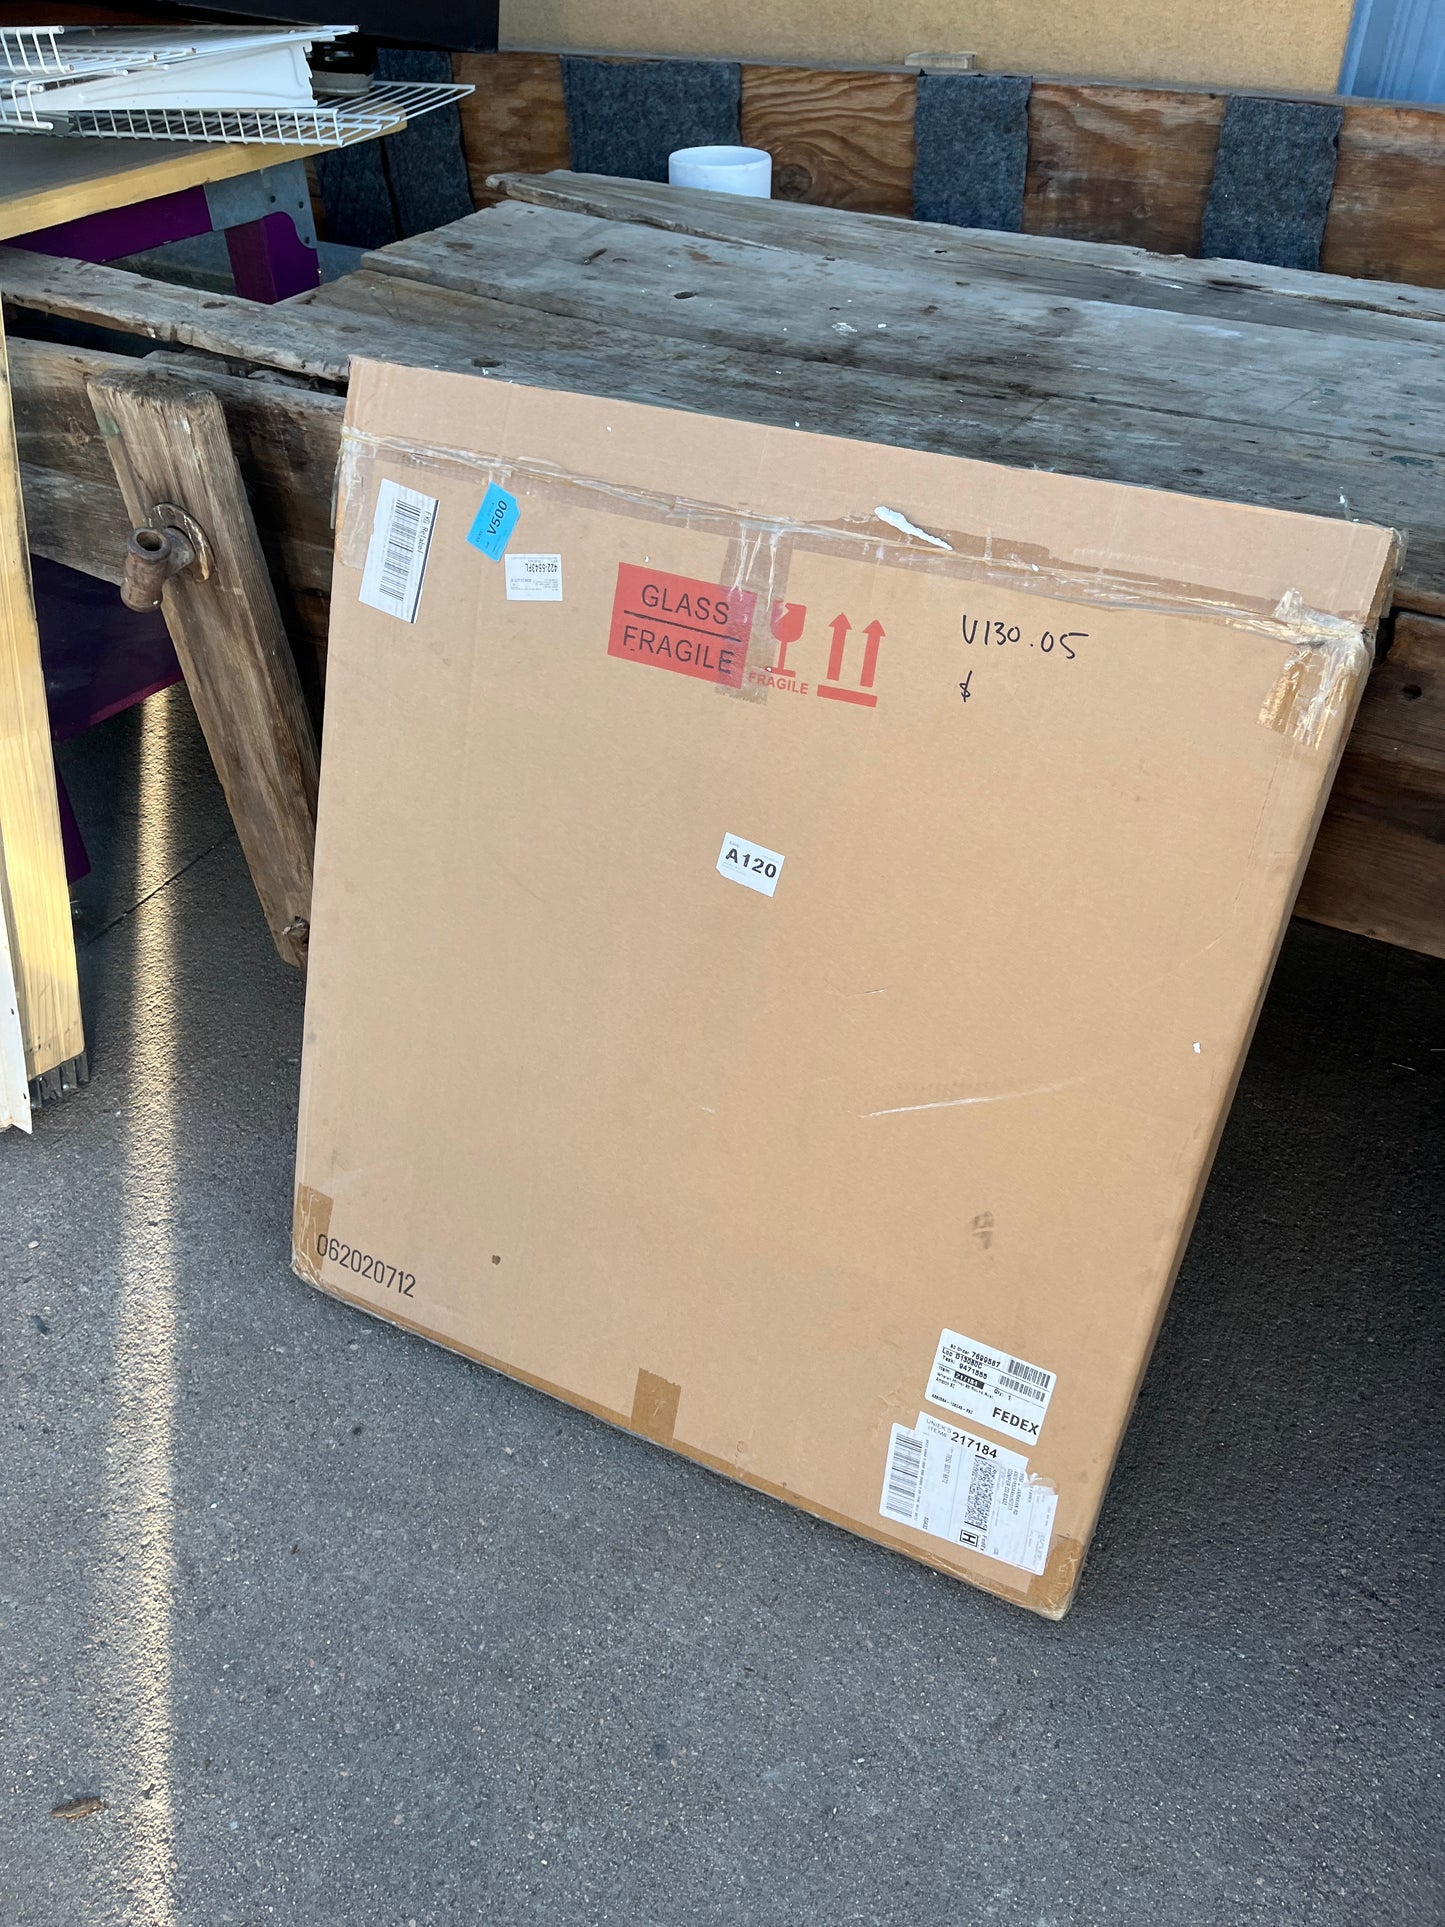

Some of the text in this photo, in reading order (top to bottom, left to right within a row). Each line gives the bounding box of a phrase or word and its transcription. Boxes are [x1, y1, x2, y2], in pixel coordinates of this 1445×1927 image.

[416, 511, 432, 554] FXG Relabel
[487, 500, 508, 535] V500
[641, 584, 730, 625] GLASS
[623, 625, 734, 675] FRAGILE
[748, 672, 809, 695] FRAGILE
[725, 847, 777, 878] A120
[317, 1233, 416, 1298] 062020712
[992, 1406, 1039, 1435] FEDEX
[951, 1431, 997, 1459] 217184
